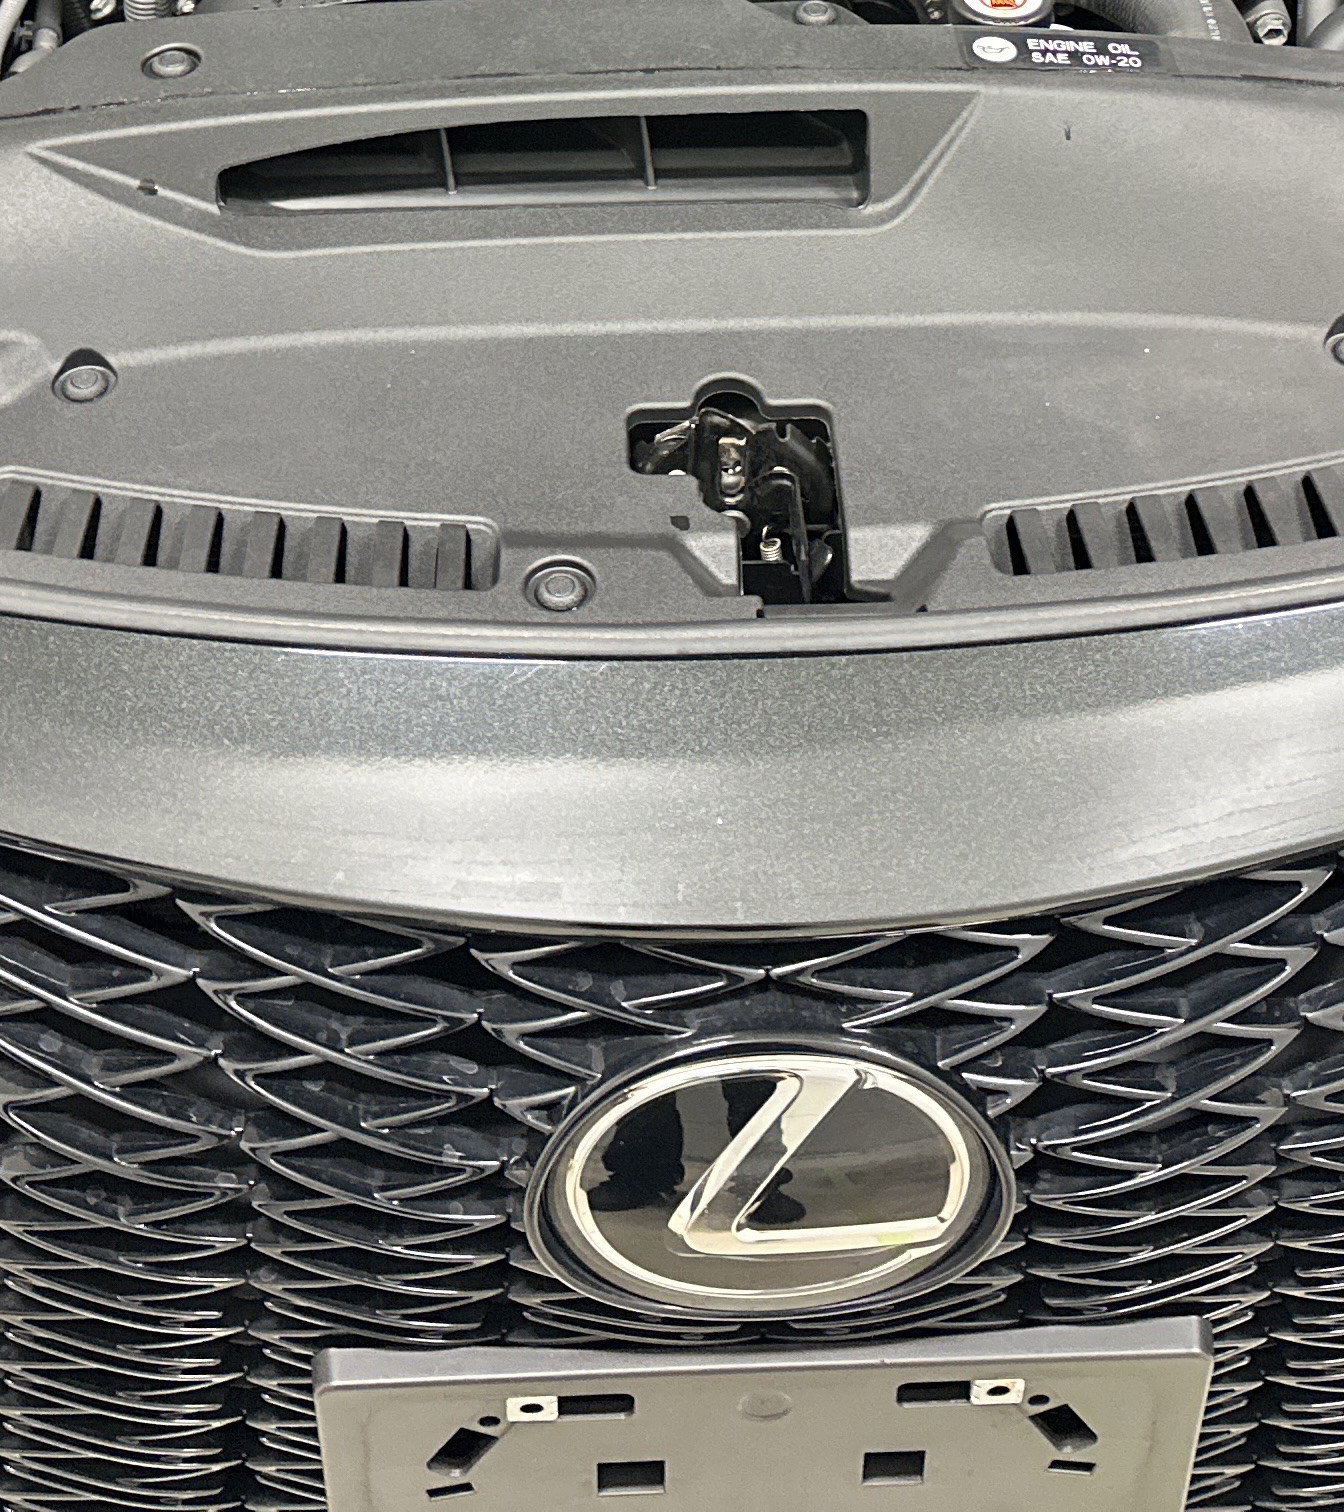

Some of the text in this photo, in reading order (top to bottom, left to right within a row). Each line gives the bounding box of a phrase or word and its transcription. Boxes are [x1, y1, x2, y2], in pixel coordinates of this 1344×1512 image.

[1026, 38, 1140, 55] ENGINE OIL
[1031, 52, 1142, 68] SAE 0W-20
